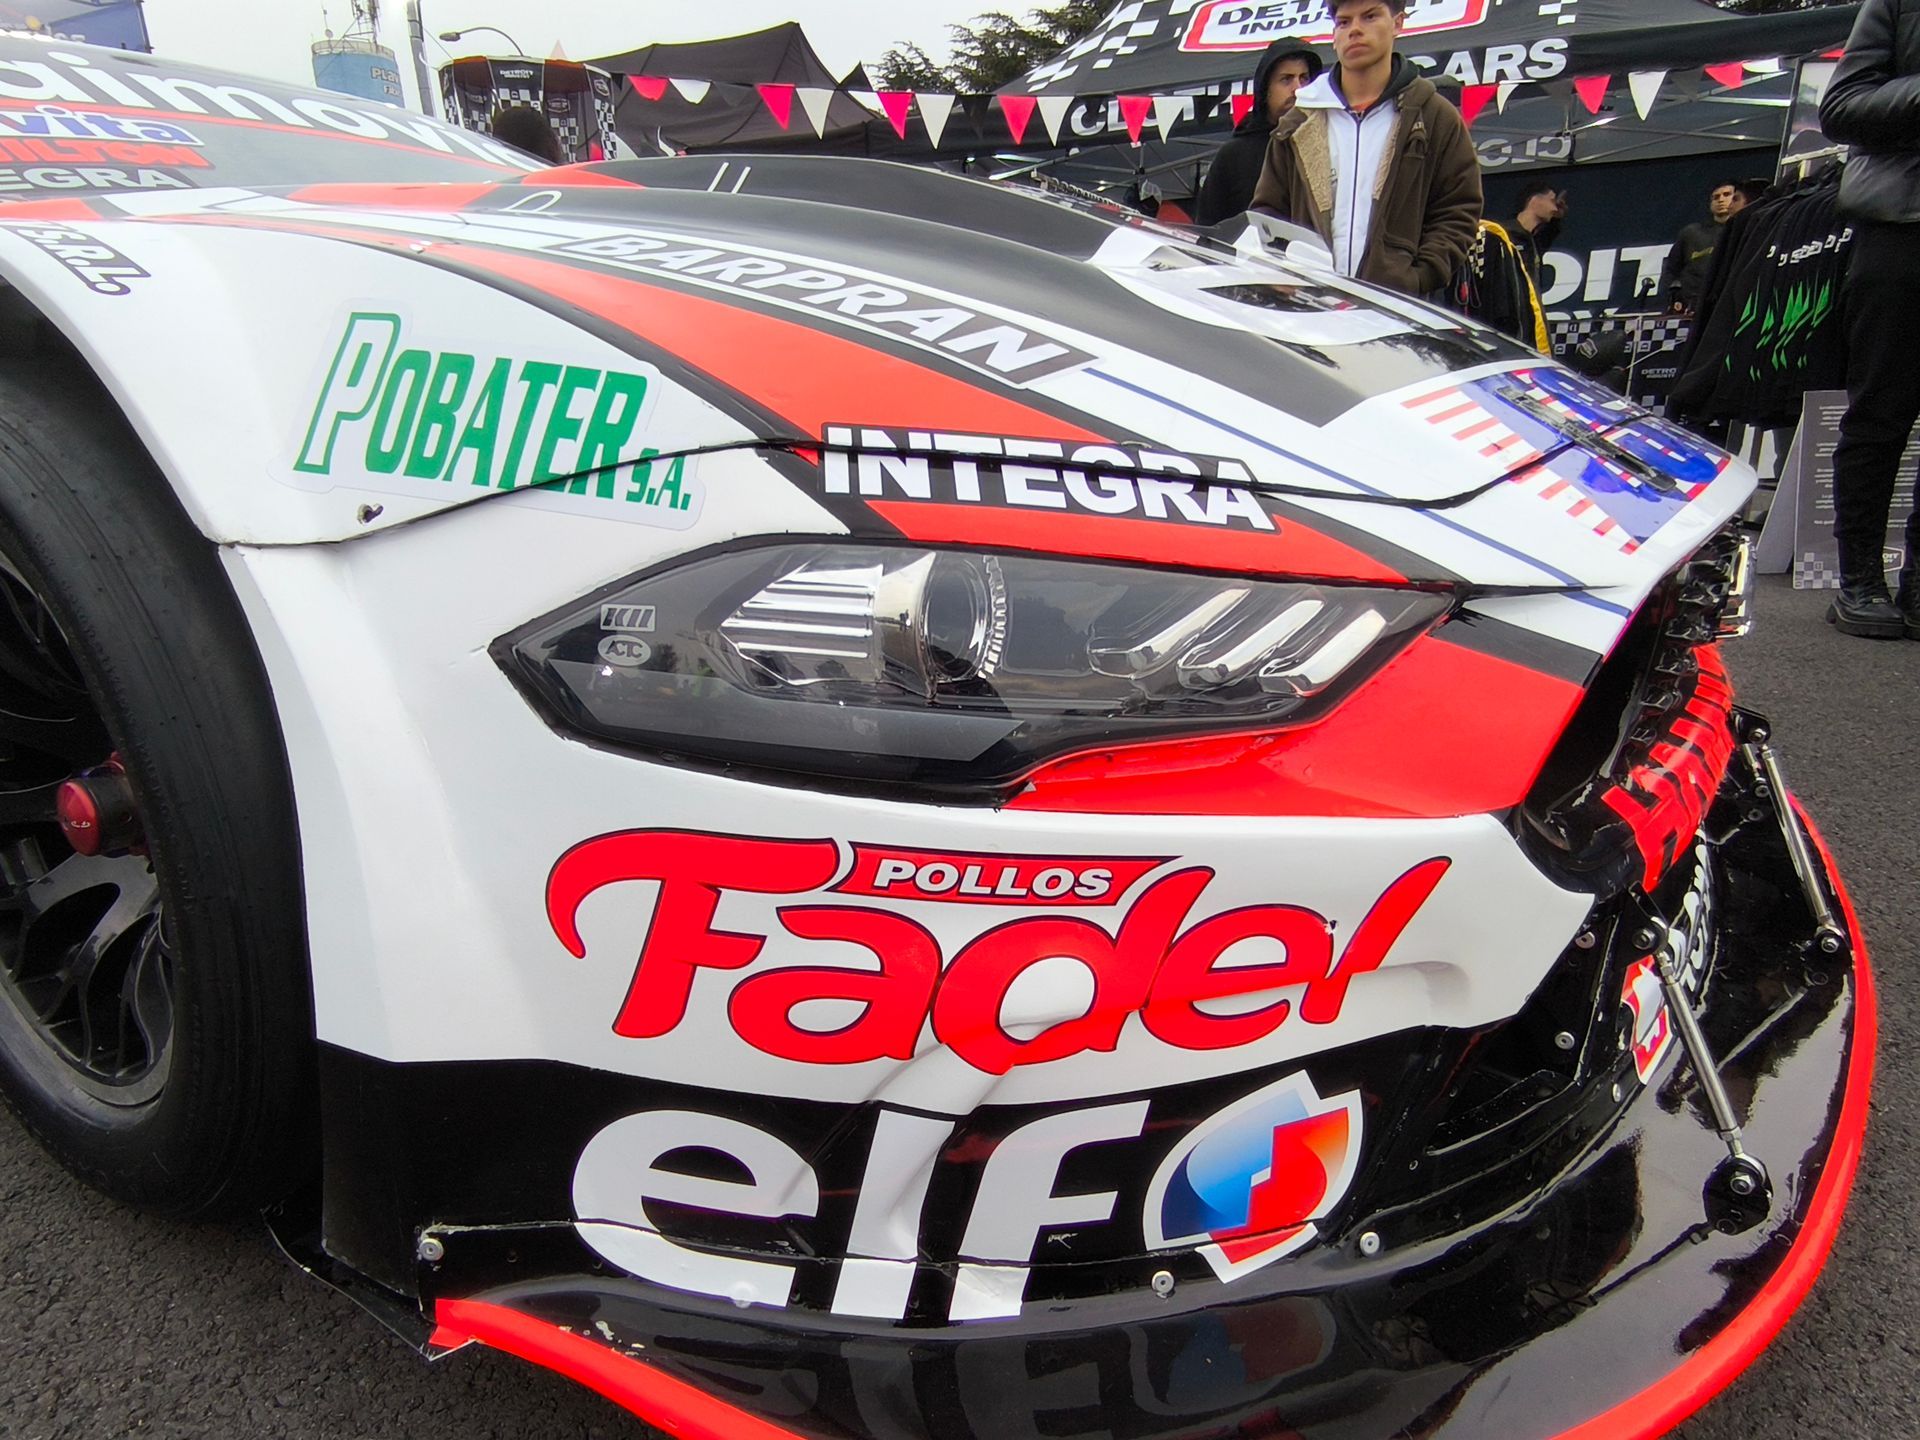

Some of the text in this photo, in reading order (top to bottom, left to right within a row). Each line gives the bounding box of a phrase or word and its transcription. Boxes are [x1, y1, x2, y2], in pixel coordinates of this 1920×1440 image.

[560, 236, 1070, 373] BARPRAN
[293, 312, 693, 511] POBATER S.A.
[823, 426, 1276, 532] INTEGRA
[545, 826, 1453, 1076] Fadel
[873, 858, 1113, 898] POLLOS
[572, 1098, 1151, 1322] elf
